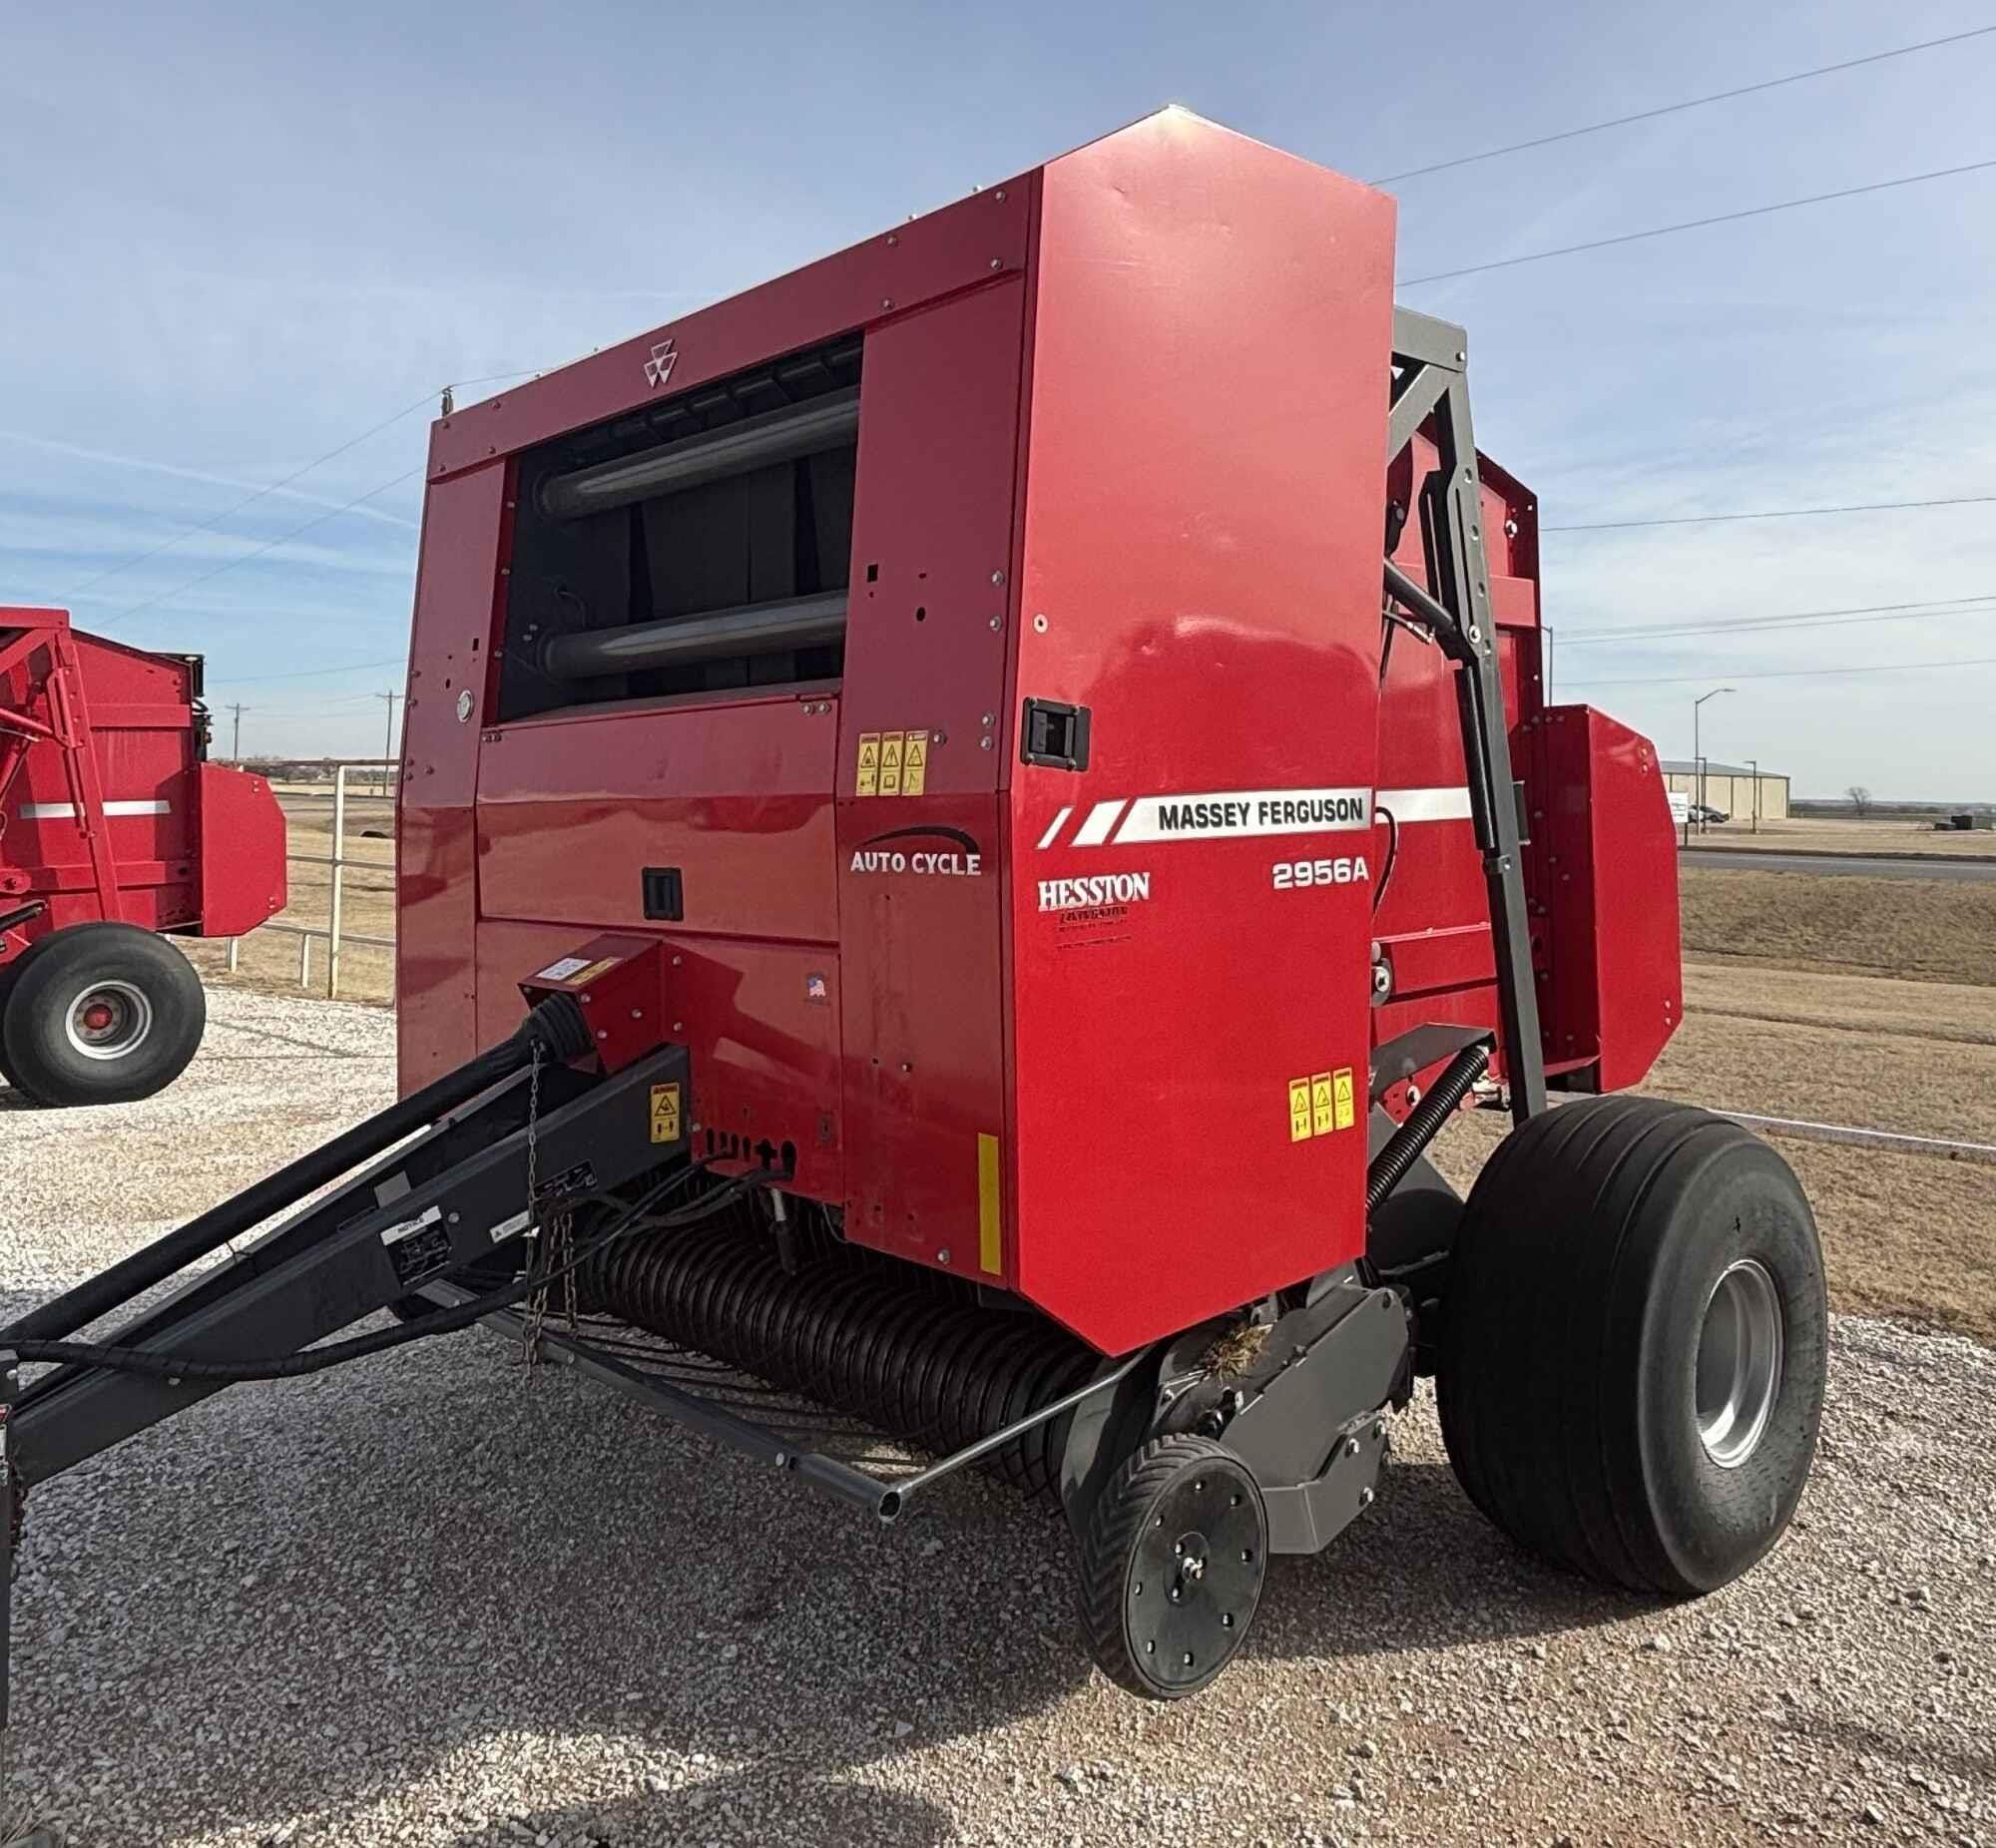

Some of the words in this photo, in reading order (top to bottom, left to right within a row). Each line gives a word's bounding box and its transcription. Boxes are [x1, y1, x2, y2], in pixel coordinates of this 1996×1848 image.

[1159, 802, 1249, 830] MASSEY
[1258, 798, 1362, 825] FERGUSON
[850, 851, 905, 873] AUTO
[911, 852, 981, 876] CYCLE
[1272, 857, 1368, 890] 2956A
[1037, 872, 1150, 912] HESSTON
